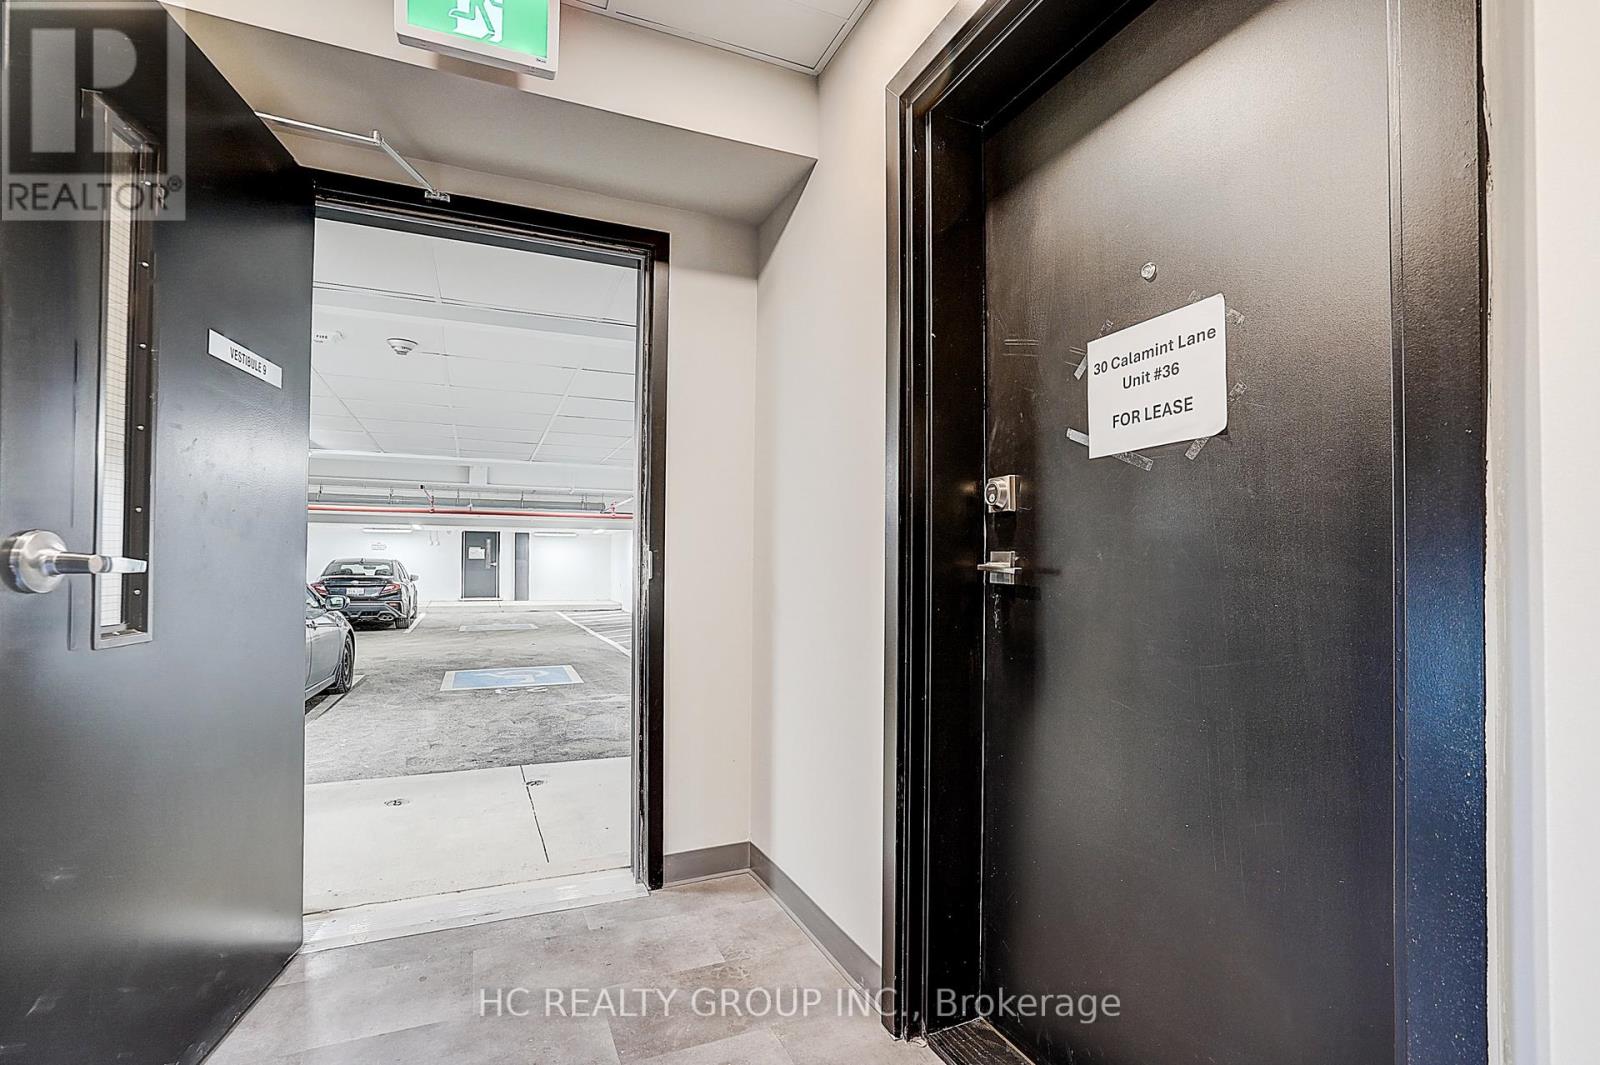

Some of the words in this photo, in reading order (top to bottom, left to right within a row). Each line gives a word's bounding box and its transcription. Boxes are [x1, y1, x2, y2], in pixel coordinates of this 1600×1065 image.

[229, 346, 262, 373] VESTIBULE
[263, 364, 267, 375] 9
[1093, 360, 1108, 375] 30
[1111, 339, 1174, 370] Calamint
[1178, 327, 1217, 349] Lane
[1122, 370, 1151, 389] Unit
[1154, 362, 1180, 381] #36
[1112, 409, 1141, 428] FOR
[1144, 396, 1193, 421] LEASE
